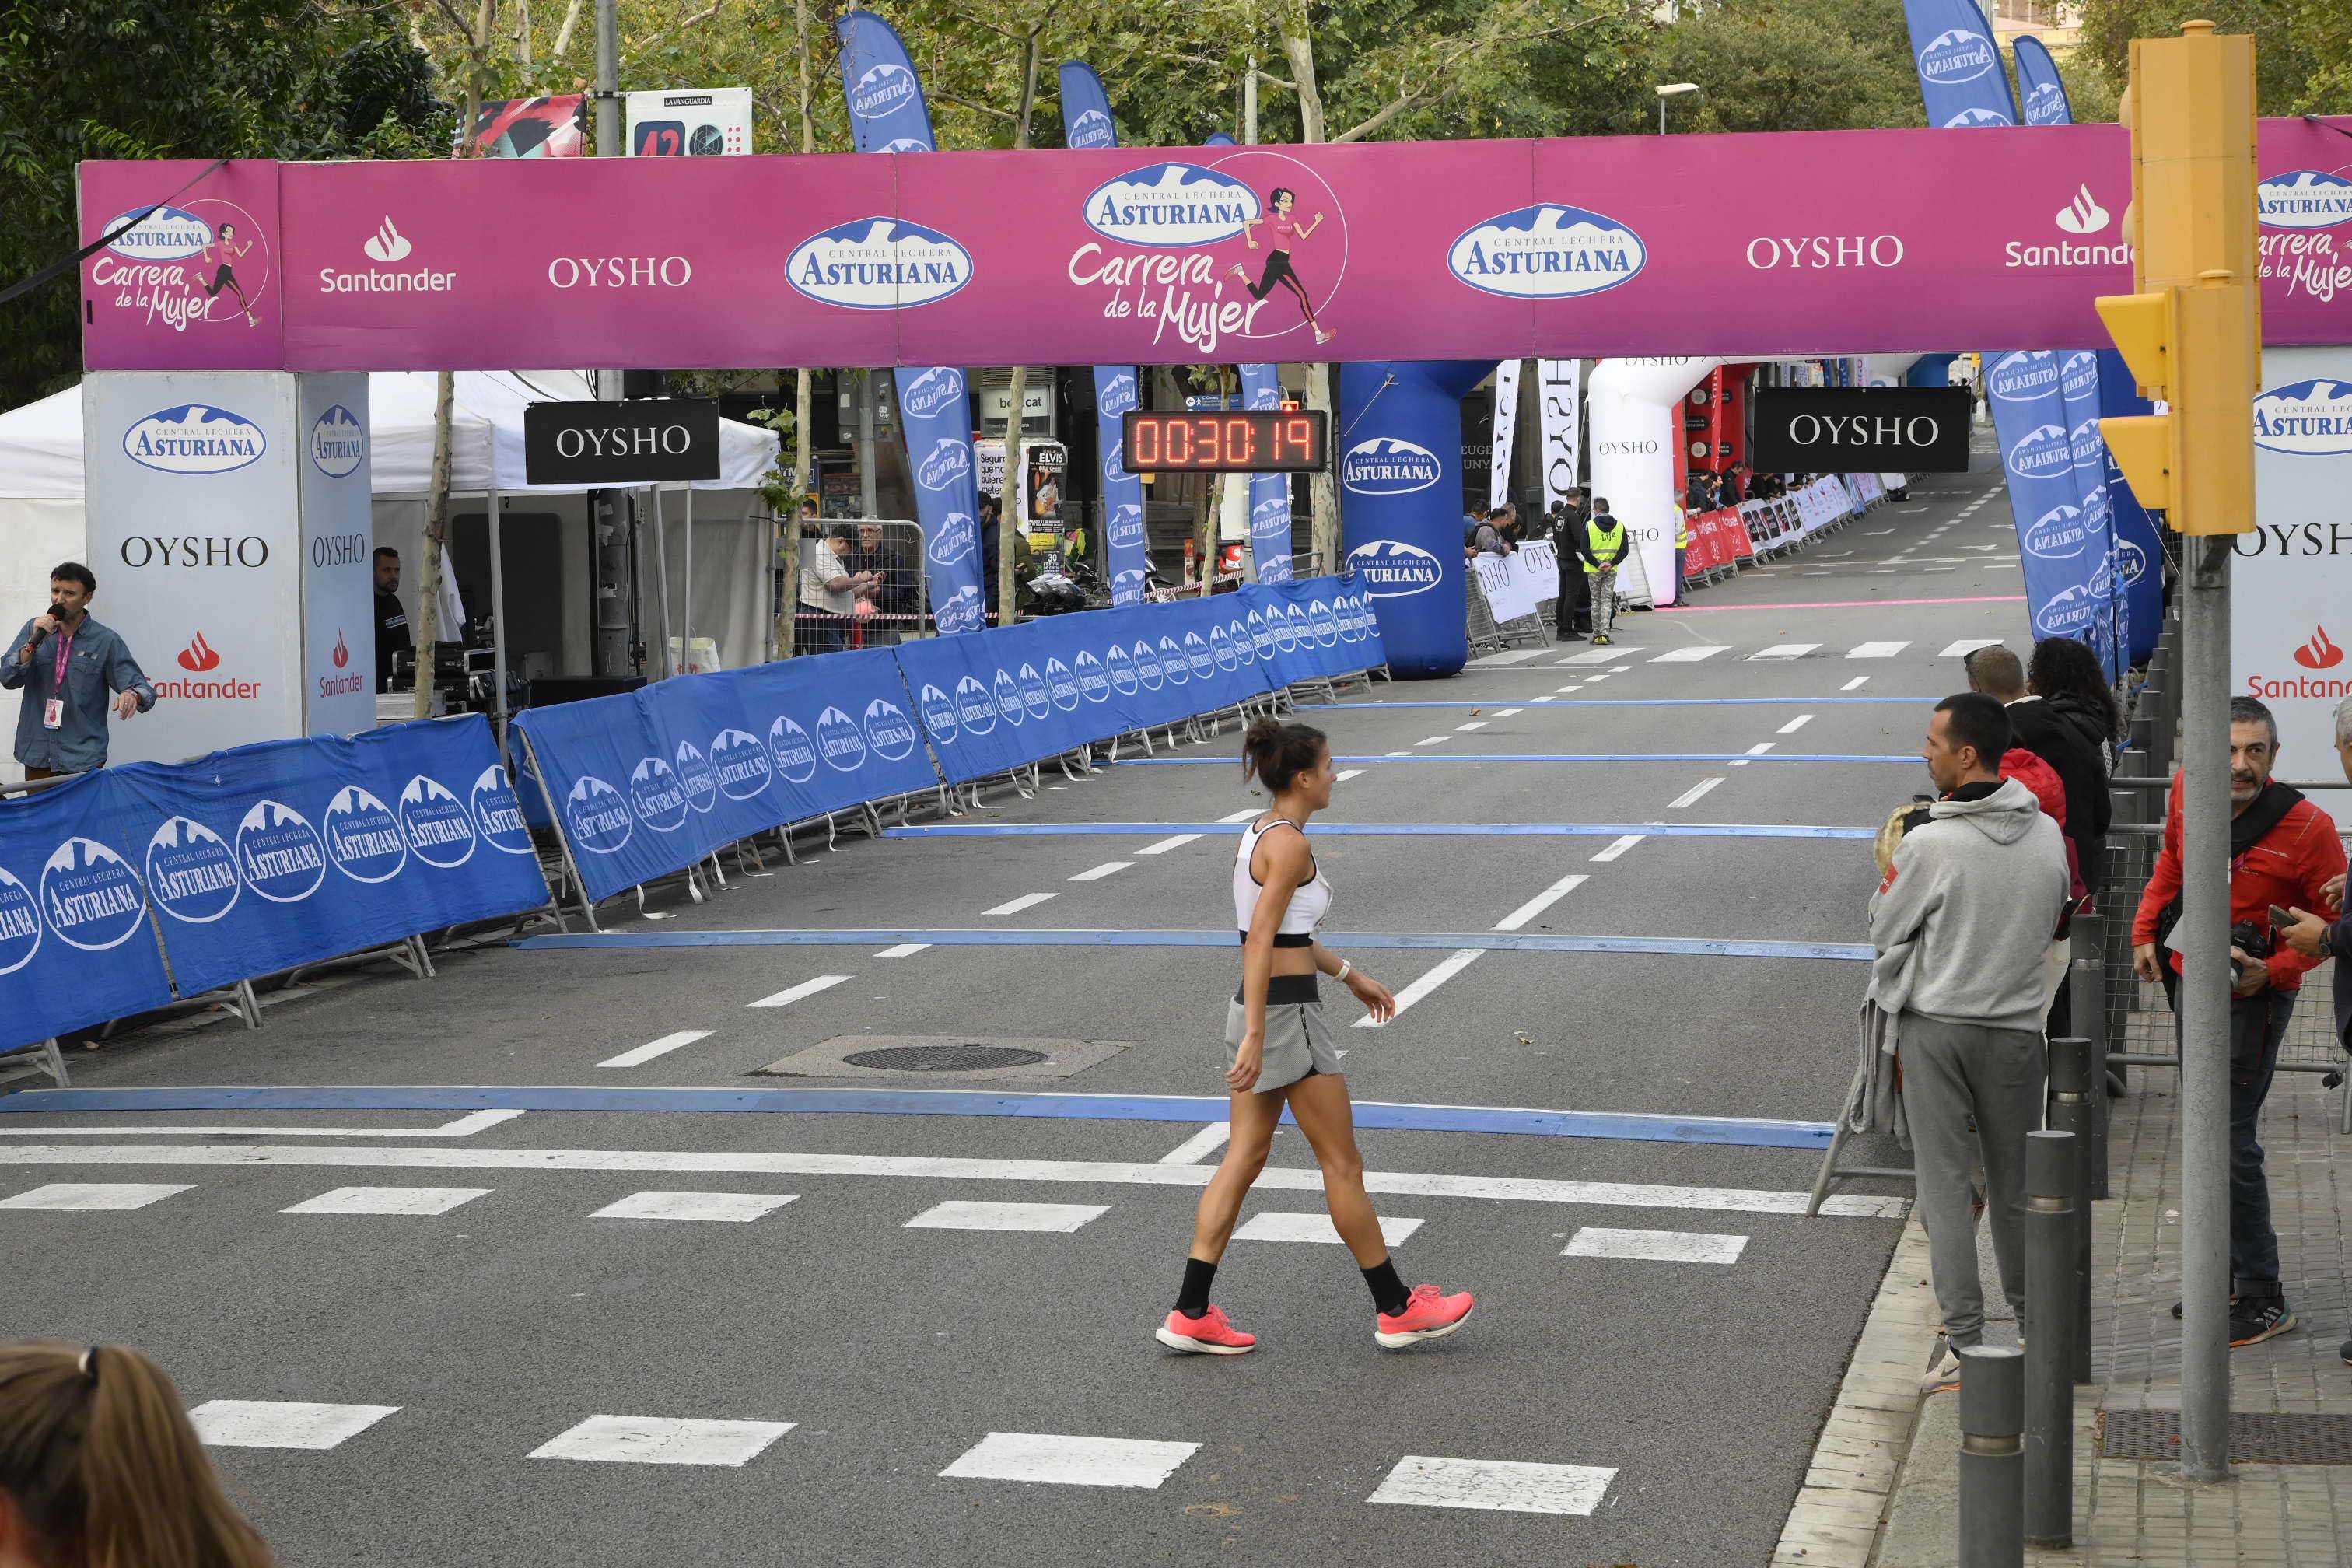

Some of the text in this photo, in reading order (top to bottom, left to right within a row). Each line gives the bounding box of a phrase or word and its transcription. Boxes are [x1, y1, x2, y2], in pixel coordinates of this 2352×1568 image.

[1185, 191, 1241, 199] LECHERA
[1097, 194, 1245, 226] ASTURIANA
[829, 248, 952, 258] CENTRAL LECHERA
[1494, 236, 1624, 247] CENTRAL LECHERA
[1746, 235, 1904, 270] OYSHO
[2005, 241, 2134, 268] Santand
[2259, 233, 2332, 256] arrera
[93, 257, 184, 285] Carrera
[800, 251, 959, 285] ASTURIANA
[1069, 243, 1213, 285] Carrera
[1463, 240, 1631, 275] ASTURIANA
[2277, 255, 2291, 278] la
[320, 268, 457, 292] Santander
[548, 256, 691, 289] OYSHO
[2287, 251, 2352, 303] Muje
[115, 286, 148, 307] de la
[146, 283, 219, 331] Mujer
[1104, 287, 1157, 318] de la
[1153, 280, 1269, 354] Mujer
[999, 397, 1042, 408] bc.cat
[2274, 405, 2327, 414] CENTRAL
[135, 430, 256, 457] ASTURIANA
[556, 425, 691, 457] OYSHO
[1134, 419, 1312, 464] 00:30:19
[1789, 415, 1940, 446] OYSHO
[315, 432, 360, 460] ASTURIANA
[1038, 453, 1063, 463] ELVIS
[1599, 440, 1657, 456] OYSHO
[981, 466, 994, 474] que
[981, 474, 1004, 484] quiere
[1346, 460, 1434, 482] ASTURIANA
[121, 536, 269, 568] OYSHO
[313, 534, 365, 568] OYSHO
[2232, 523, 2352, 557] OYSH
[1349, 562, 1435, 582] TURIANA
[1524, 545, 1552, 574] OYS
[153, 677, 261, 699] antander
[320, 673, 363, 698] Santander
[2248, 675, 2352, 698] Santan
[774, 744, 814, 768] ASTURIANA
[821, 733, 863, 758] ASTURIANA
[714, 756, 769, 786] ASTURIANA
[339, 817, 366, 831] CENTRAL
[406, 814, 472, 848] ASTURIANA
[479, 802, 527, 835] ASTUR
[252, 828, 310, 849] CENTRAL LECHERA
[332, 824, 403, 863] ASTURIANA
[163, 847, 224, 866] CENTRAL LECHERA
[244, 842, 322, 882] ASTURIANA
[59, 868, 125, 891] CENTRAL LECHERA
[155, 861, 236, 902] ASTURIANA
[50, 883, 140, 929] ASTURIANA
